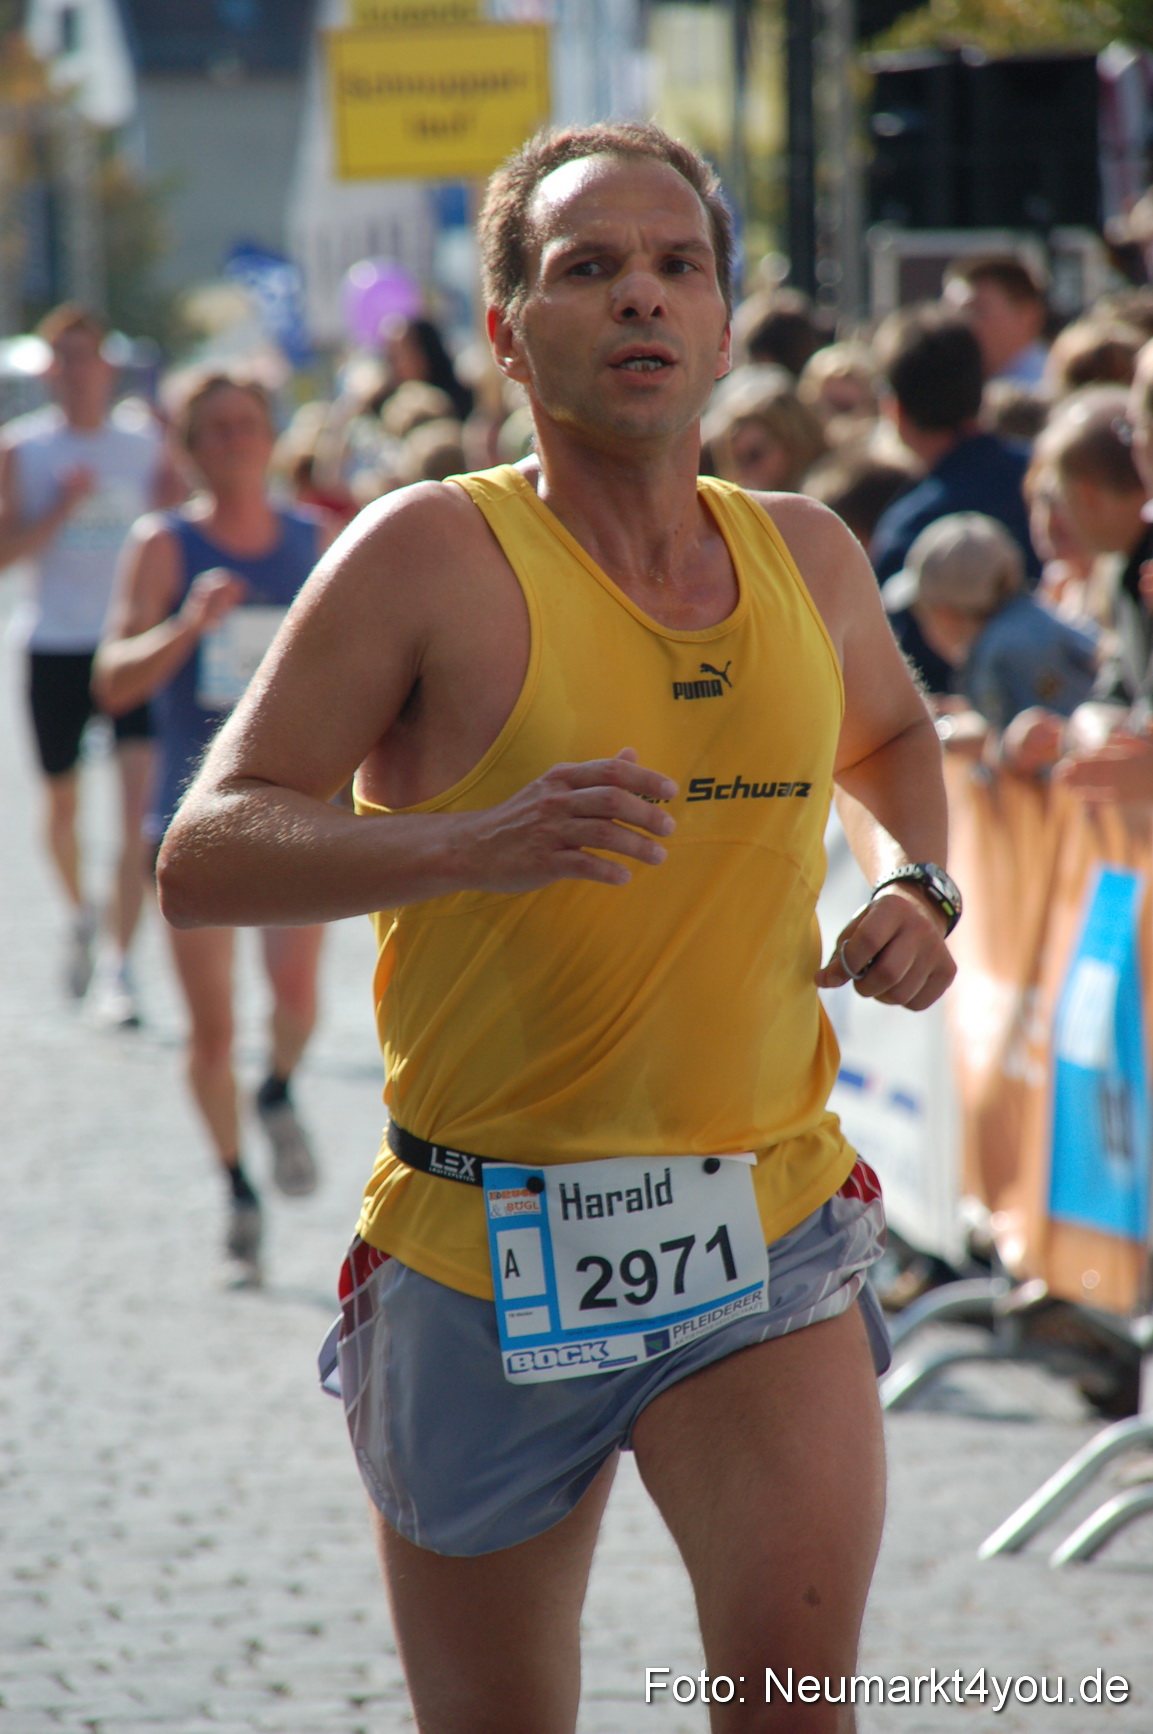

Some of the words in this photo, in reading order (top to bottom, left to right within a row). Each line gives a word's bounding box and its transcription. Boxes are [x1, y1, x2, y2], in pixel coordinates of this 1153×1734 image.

[672, 679, 723, 700] PUMA
[686, 775, 813, 802] Schwarz
[430, 1147, 476, 1177] LEX
[559, 1167, 673, 1221] Harald
[504, 1248, 520, 1279] A
[576, 1224, 738, 1311] 2971
[672, 1291, 763, 1339] PFLEIDERER
[507, 1340, 609, 1374] BOCK
